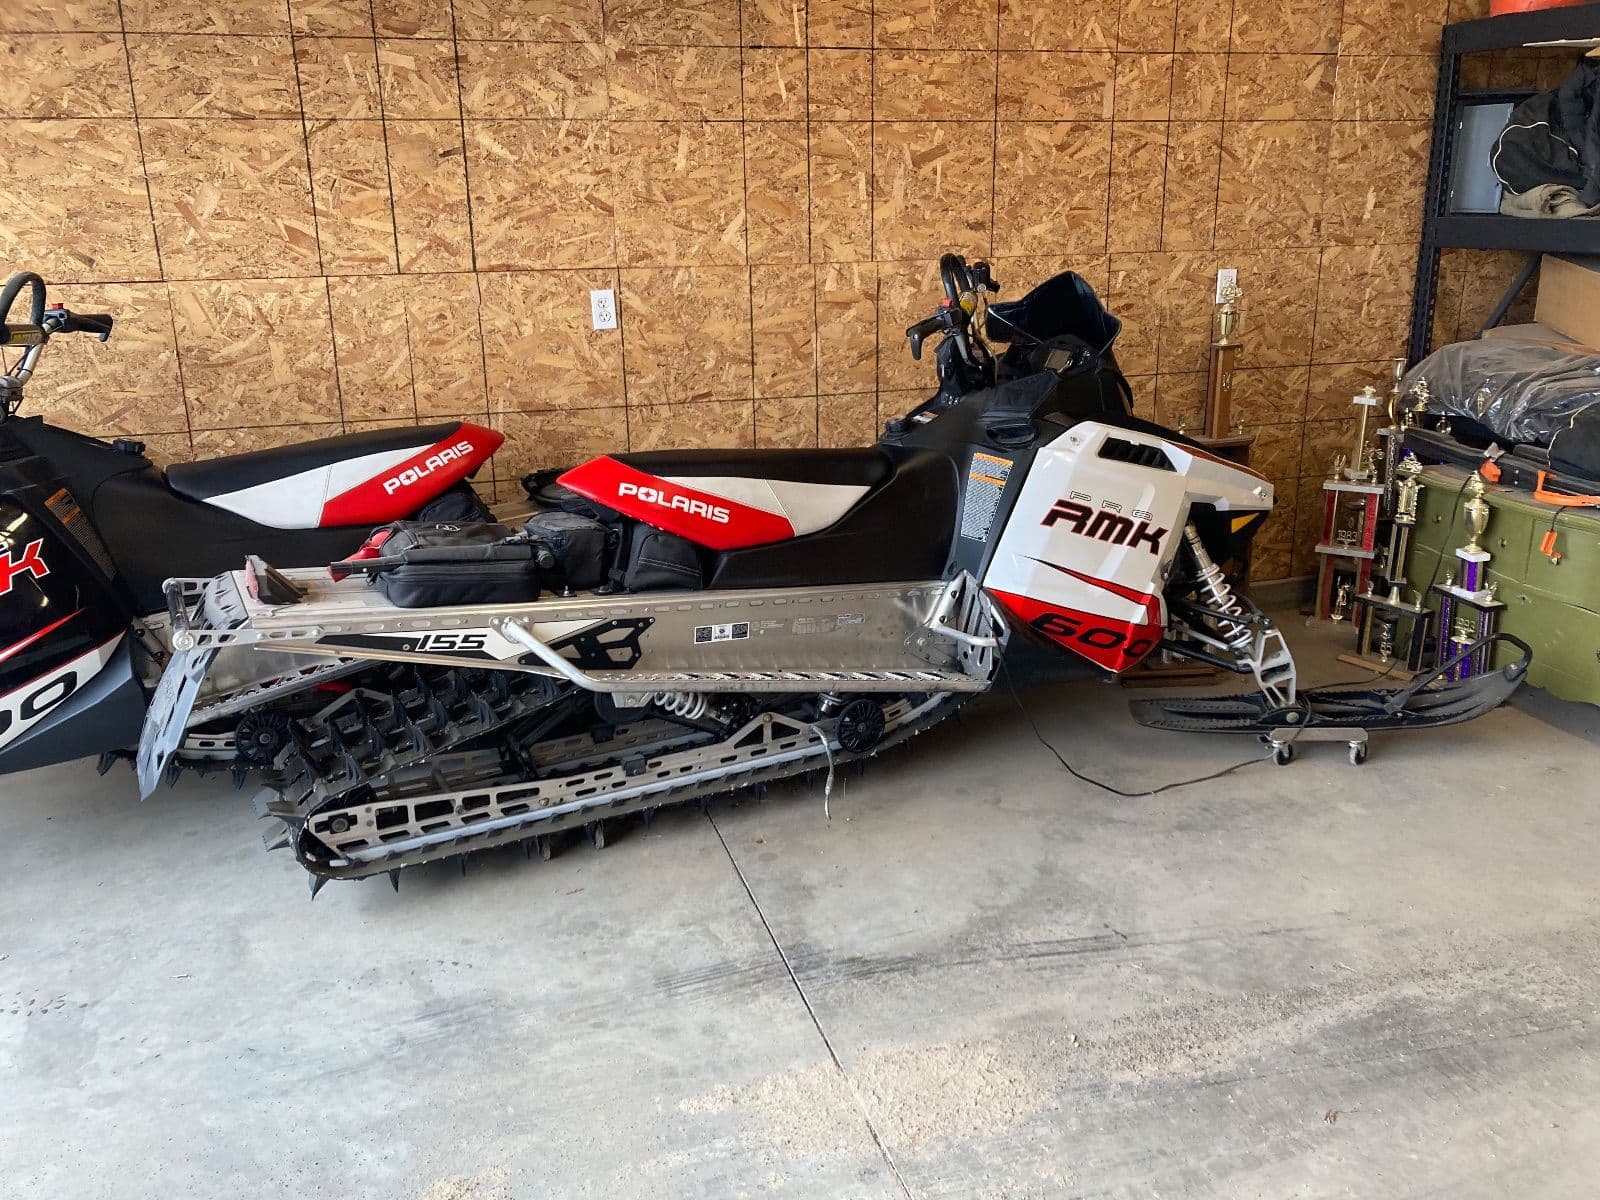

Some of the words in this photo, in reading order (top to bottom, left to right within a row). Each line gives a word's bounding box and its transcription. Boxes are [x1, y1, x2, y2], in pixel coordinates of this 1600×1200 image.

[382, 440, 474, 496] POLARIS
[618, 482, 730, 524] POLARIS
[1069, 490, 1153, 521] PRO
[1040, 499, 1169, 555] RMK
[418, 634, 488, 650] 155
[1029, 612, 1151, 657] 600
[0, 671, 78, 736] 0
